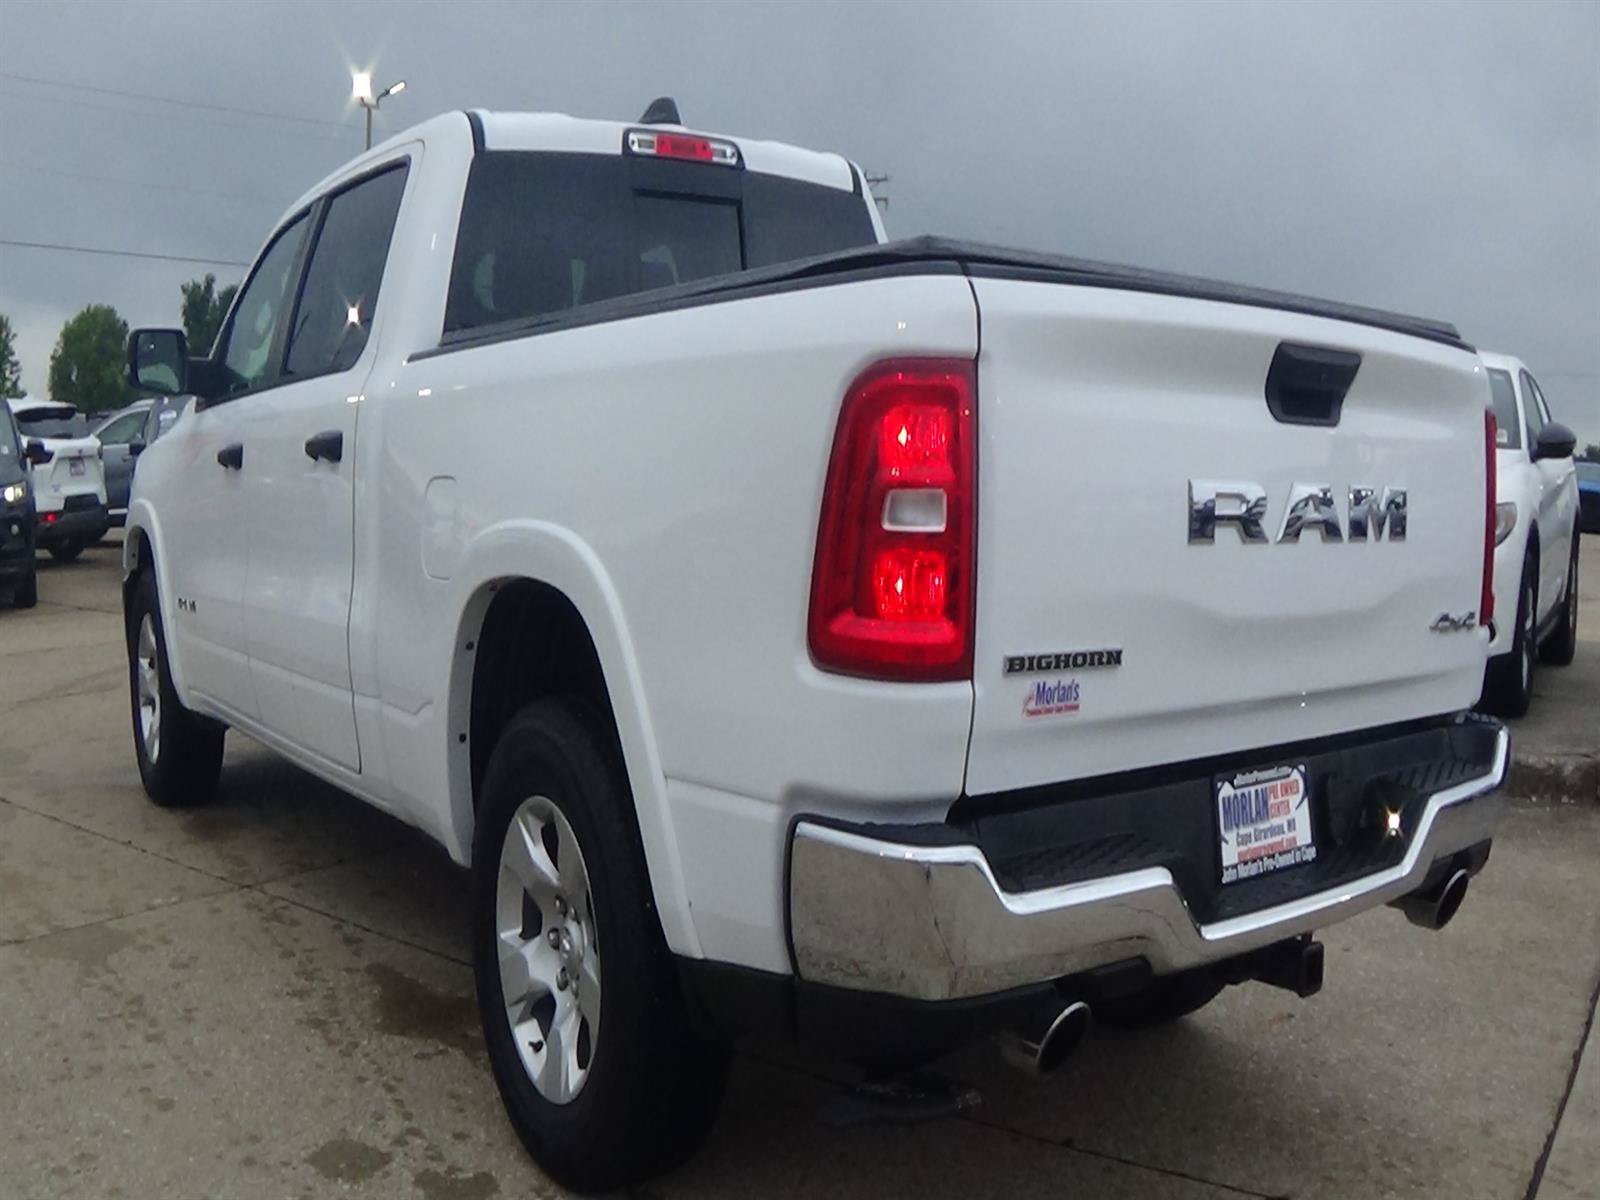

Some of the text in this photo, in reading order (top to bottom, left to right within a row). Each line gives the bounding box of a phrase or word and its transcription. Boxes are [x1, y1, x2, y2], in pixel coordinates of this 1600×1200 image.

[1187, 479, 1407, 545] RAM
[1005, 649, 1123, 673] BIGHORN
[1035, 679, 1080, 706] Morlan's
[1222, 787, 1269, 832] MORLAN
